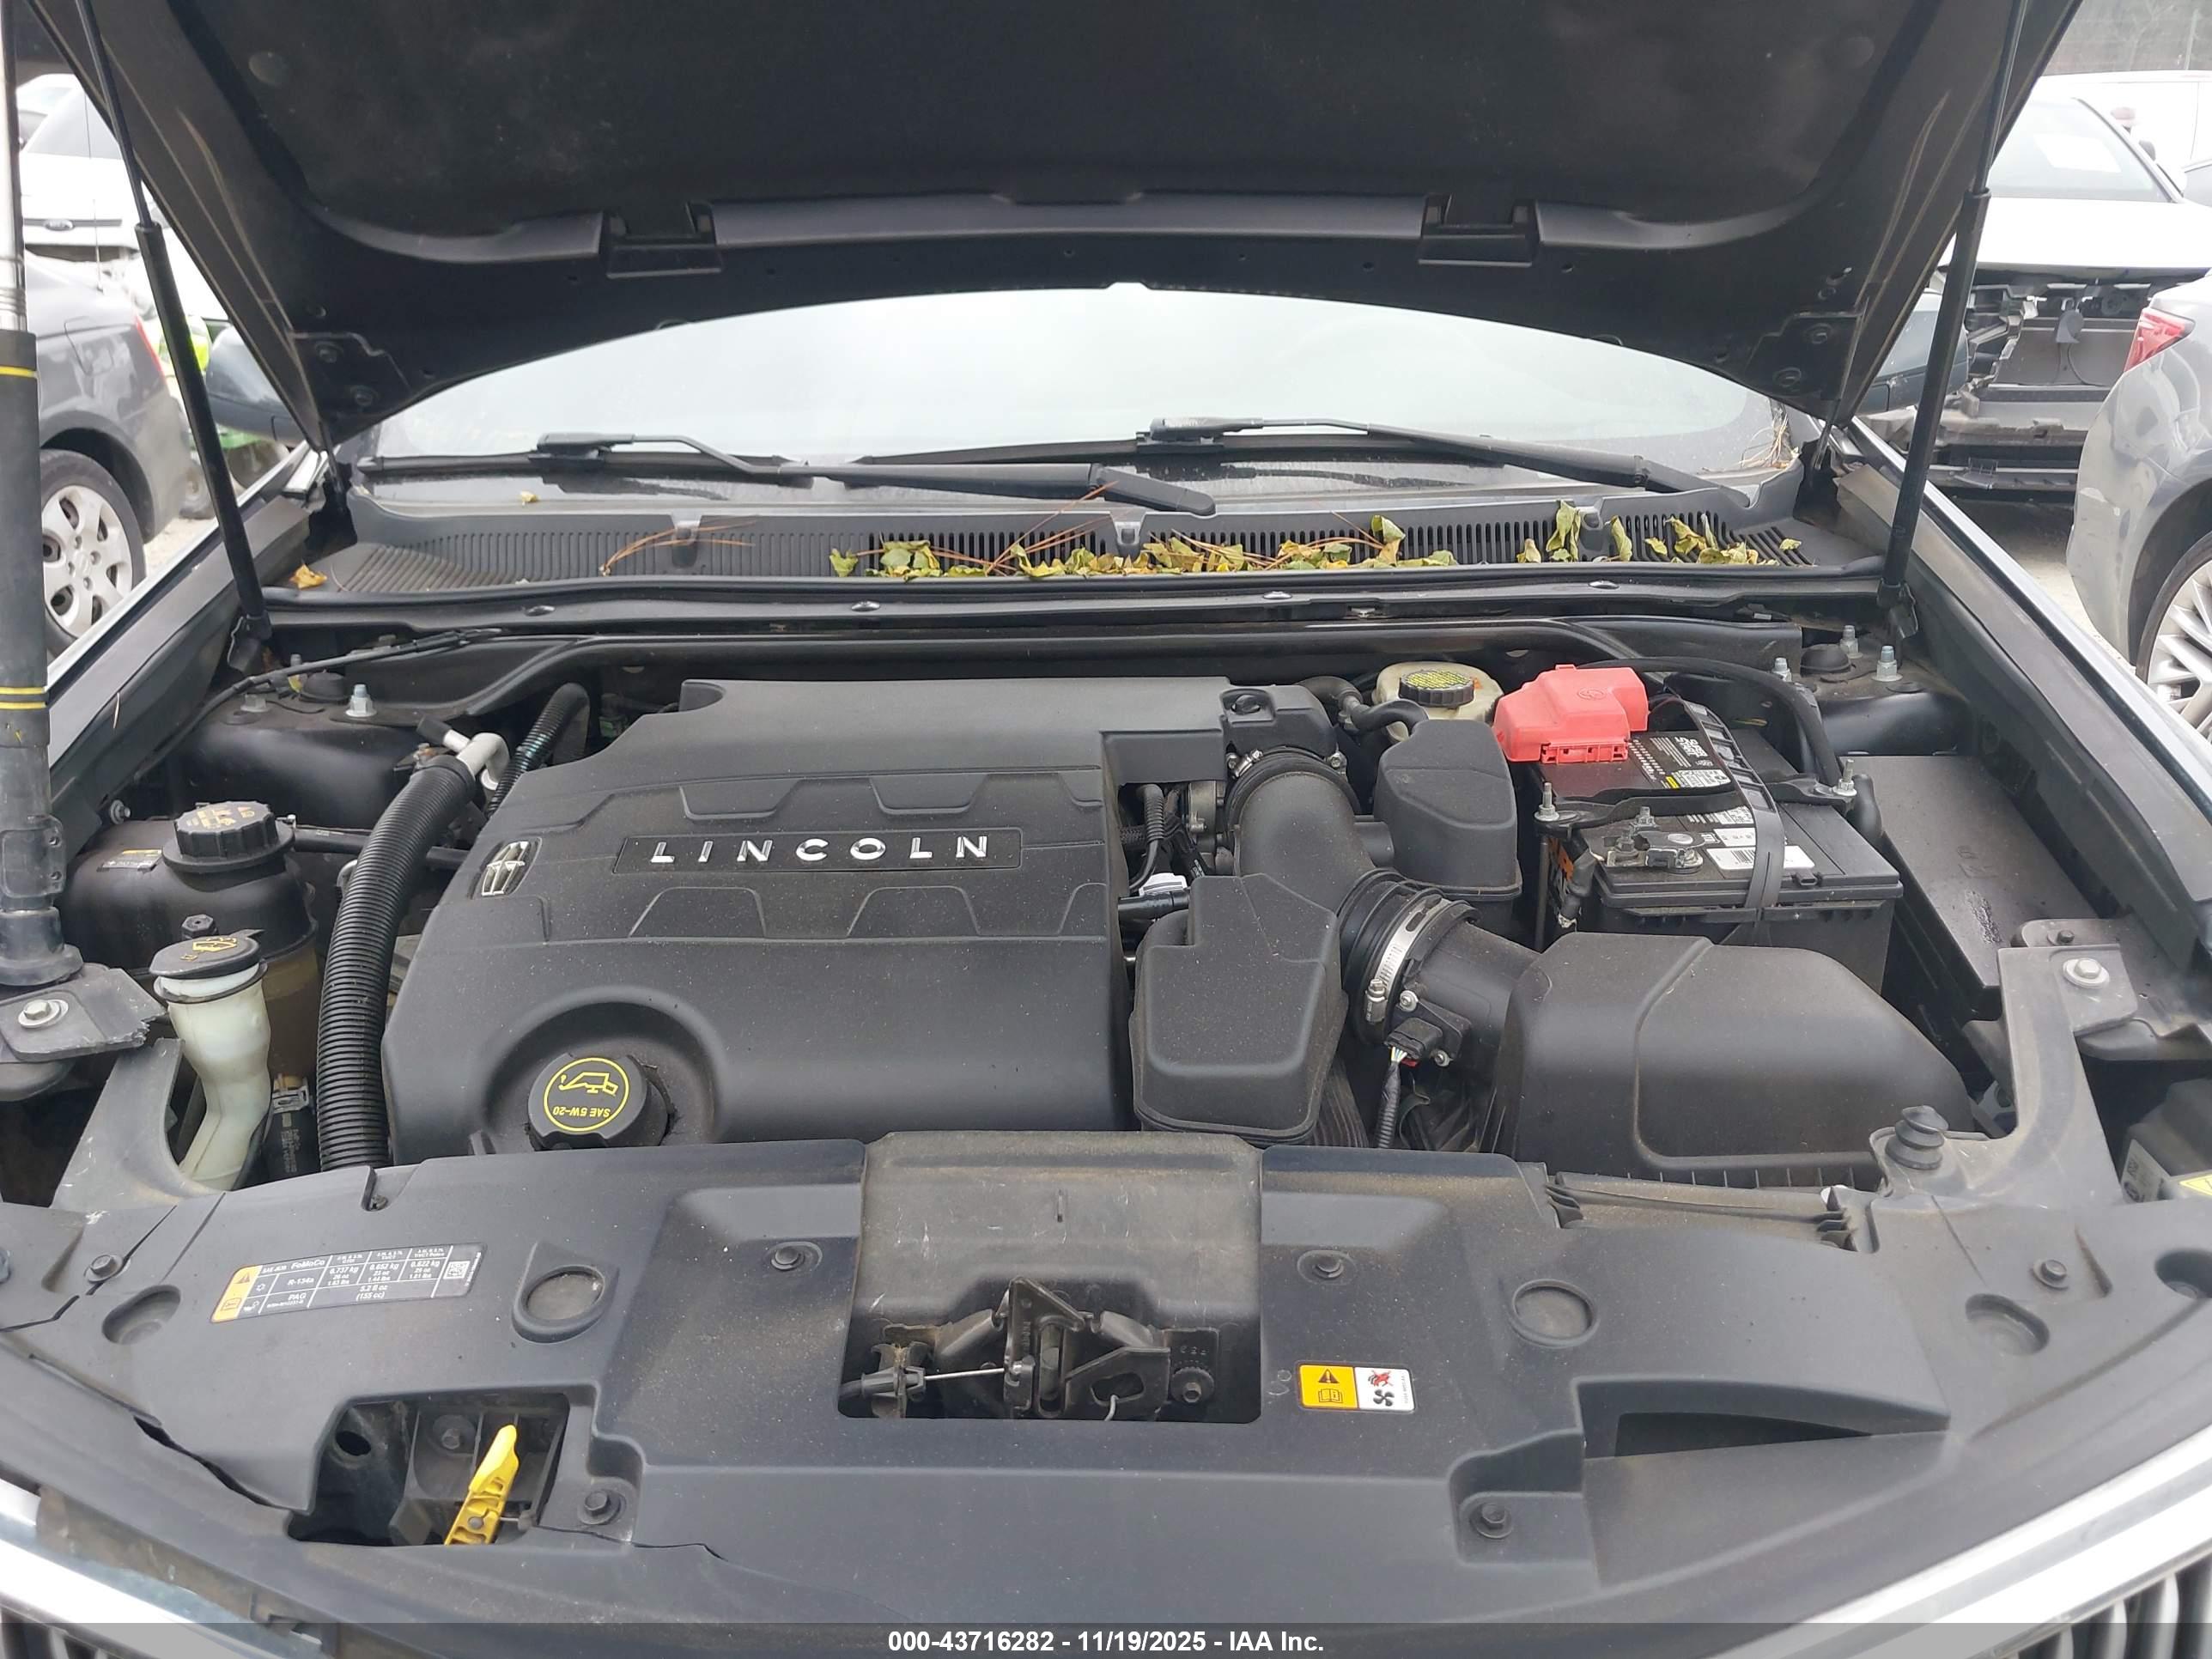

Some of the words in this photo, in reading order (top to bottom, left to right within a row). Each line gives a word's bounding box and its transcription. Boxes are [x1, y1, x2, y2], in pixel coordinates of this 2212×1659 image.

[1674, 736, 1701, 757] START
[1686, 738, 1709, 757] SUPER
[650, 836, 988, 863] LINCOLN
[552, 1105, 588, 1117] 5W-20
[589, 1108, 611, 1118] SAE
[290, 1259, 325, 1269] FoMoCo
[349, 1266, 359, 1274] kg
[286, 1277, 314, 1285] R-134a
[288, 1292, 307, 1301] PAG
[356, 1291, 374, 1302] (155
